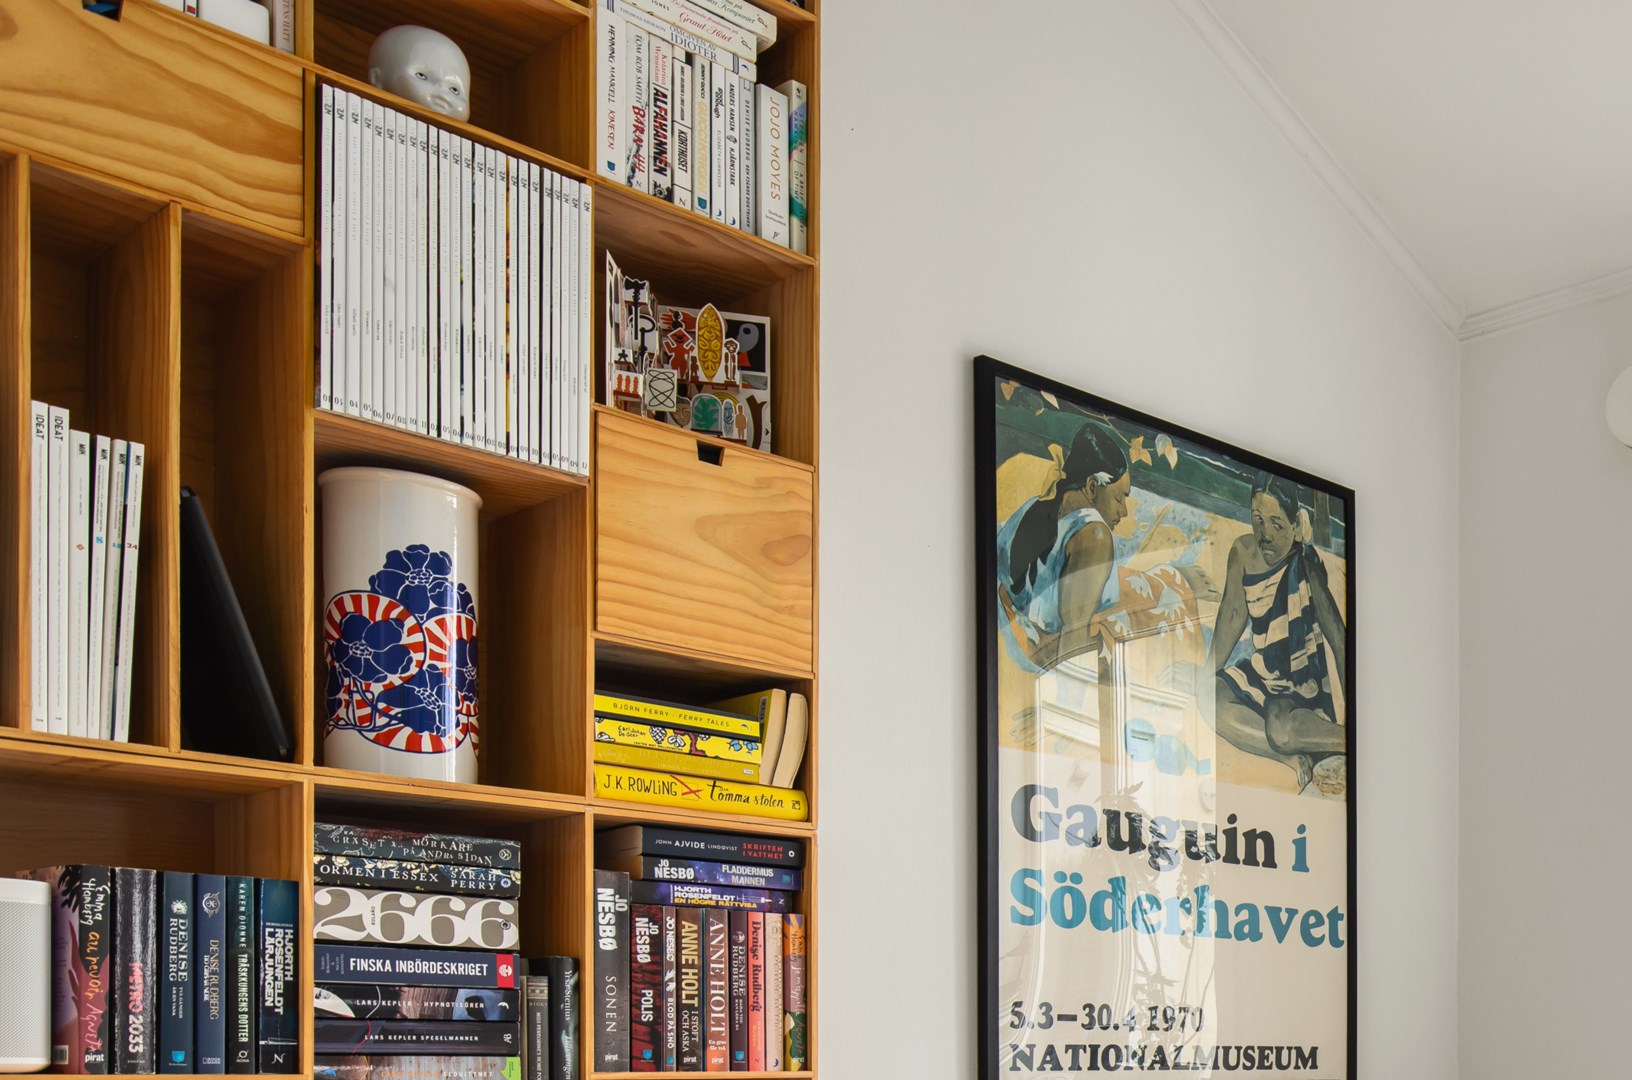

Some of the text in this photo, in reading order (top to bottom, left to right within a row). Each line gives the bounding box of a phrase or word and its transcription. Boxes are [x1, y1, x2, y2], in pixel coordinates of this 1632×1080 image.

[669, 26, 706, 46] OMGIVEN
[670, 33, 717, 61] IDIOTER
[635, 34, 643, 104] TOM ROB SMITH
[607, 24, 616, 150] HENNING MANKELL KINESEN
[770, 97, 780, 139] JOJO
[653, 88, 668, 177] ALFAHANNEN
[678, 129, 687, 173] KORTHUSET
[770, 145, 780, 201] MOYES
[36, 414, 44, 440] IDEAT
[55, 416, 63, 441] IDEAT
[612, 702, 730, 728] BJÖRN FERRY FERRY TALES
[604, 774, 626, 791] J.K.
[754, 795, 785, 809] stolen
[1010, 783, 1309, 873] Gauguin i
[674, 839, 705, 849] AJVIDE
[742, 843, 784, 852] SKRIFTEN
[747, 851, 784, 860] VATTNET
[320, 864, 439, 882] ORMEN I ESSEX
[450, 871, 497, 881] SARAH
[655, 867, 695, 879] NESBØ
[658, 859, 669, 868] JO
[722, 864, 774, 877] FLADDERMUS
[450, 881, 496, 891] PERRY
[731, 876, 765, 886] MANNEN
[238, 883, 246, 911] KAREN
[615, 895, 628, 912] JO
[674, 891, 735, 901] ROSENFELDT
[719, 900, 757, 908] RÄTTVISA
[1009, 867, 1345, 949] Söderhavet
[313, 887, 519, 949] 2666
[597, 888, 618, 951] NESBØ
[649, 922, 659, 935] JO
[169, 917, 177, 982] RUDBERG
[178, 918, 188, 982] DENISE
[635, 917, 651, 963] NESBØ
[666, 916, 674, 962] JO NESBØ
[265, 927, 275, 1007] LÄRJUNGEN
[284, 929, 293, 981] HJORTH
[350, 958, 392, 972] FINSKA
[396, 958, 488, 976] INBÖRDESKRIGET
[681, 921, 698, 1007] ANNE HOLT
[750, 921, 763, 1012] Denise Rudberg
[209, 939, 219, 1020] DENISE RUDBERG
[238, 954, 250, 1012] TRÄSKKUNGENS
[274, 929, 284, 1015] ROSENFELDT
[564, 970, 572, 990] Yrsa
[710, 918, 726, 1036] ANNE HOLT
[128, 962, 143, 1013] METRO
[424, 1001, 485, 1009] HYPNOTISÖREN
[564, 990, 572, 1021] Stenius
[605, 976, 617, 1033] SONEN
[641, 989, 653, 1022] POLIS
[238, 1014, 248, 1042] DOTTER
[691, 1015, 699, 1041] STOFT
[1146, 1005, 1205, 1033] 1970
[128, 1014, 143, 1053] 2033
[84, 1053, 104, 1063] pirat
[1009, 1043, 1319, 1072] NATIONALMUSEUM
